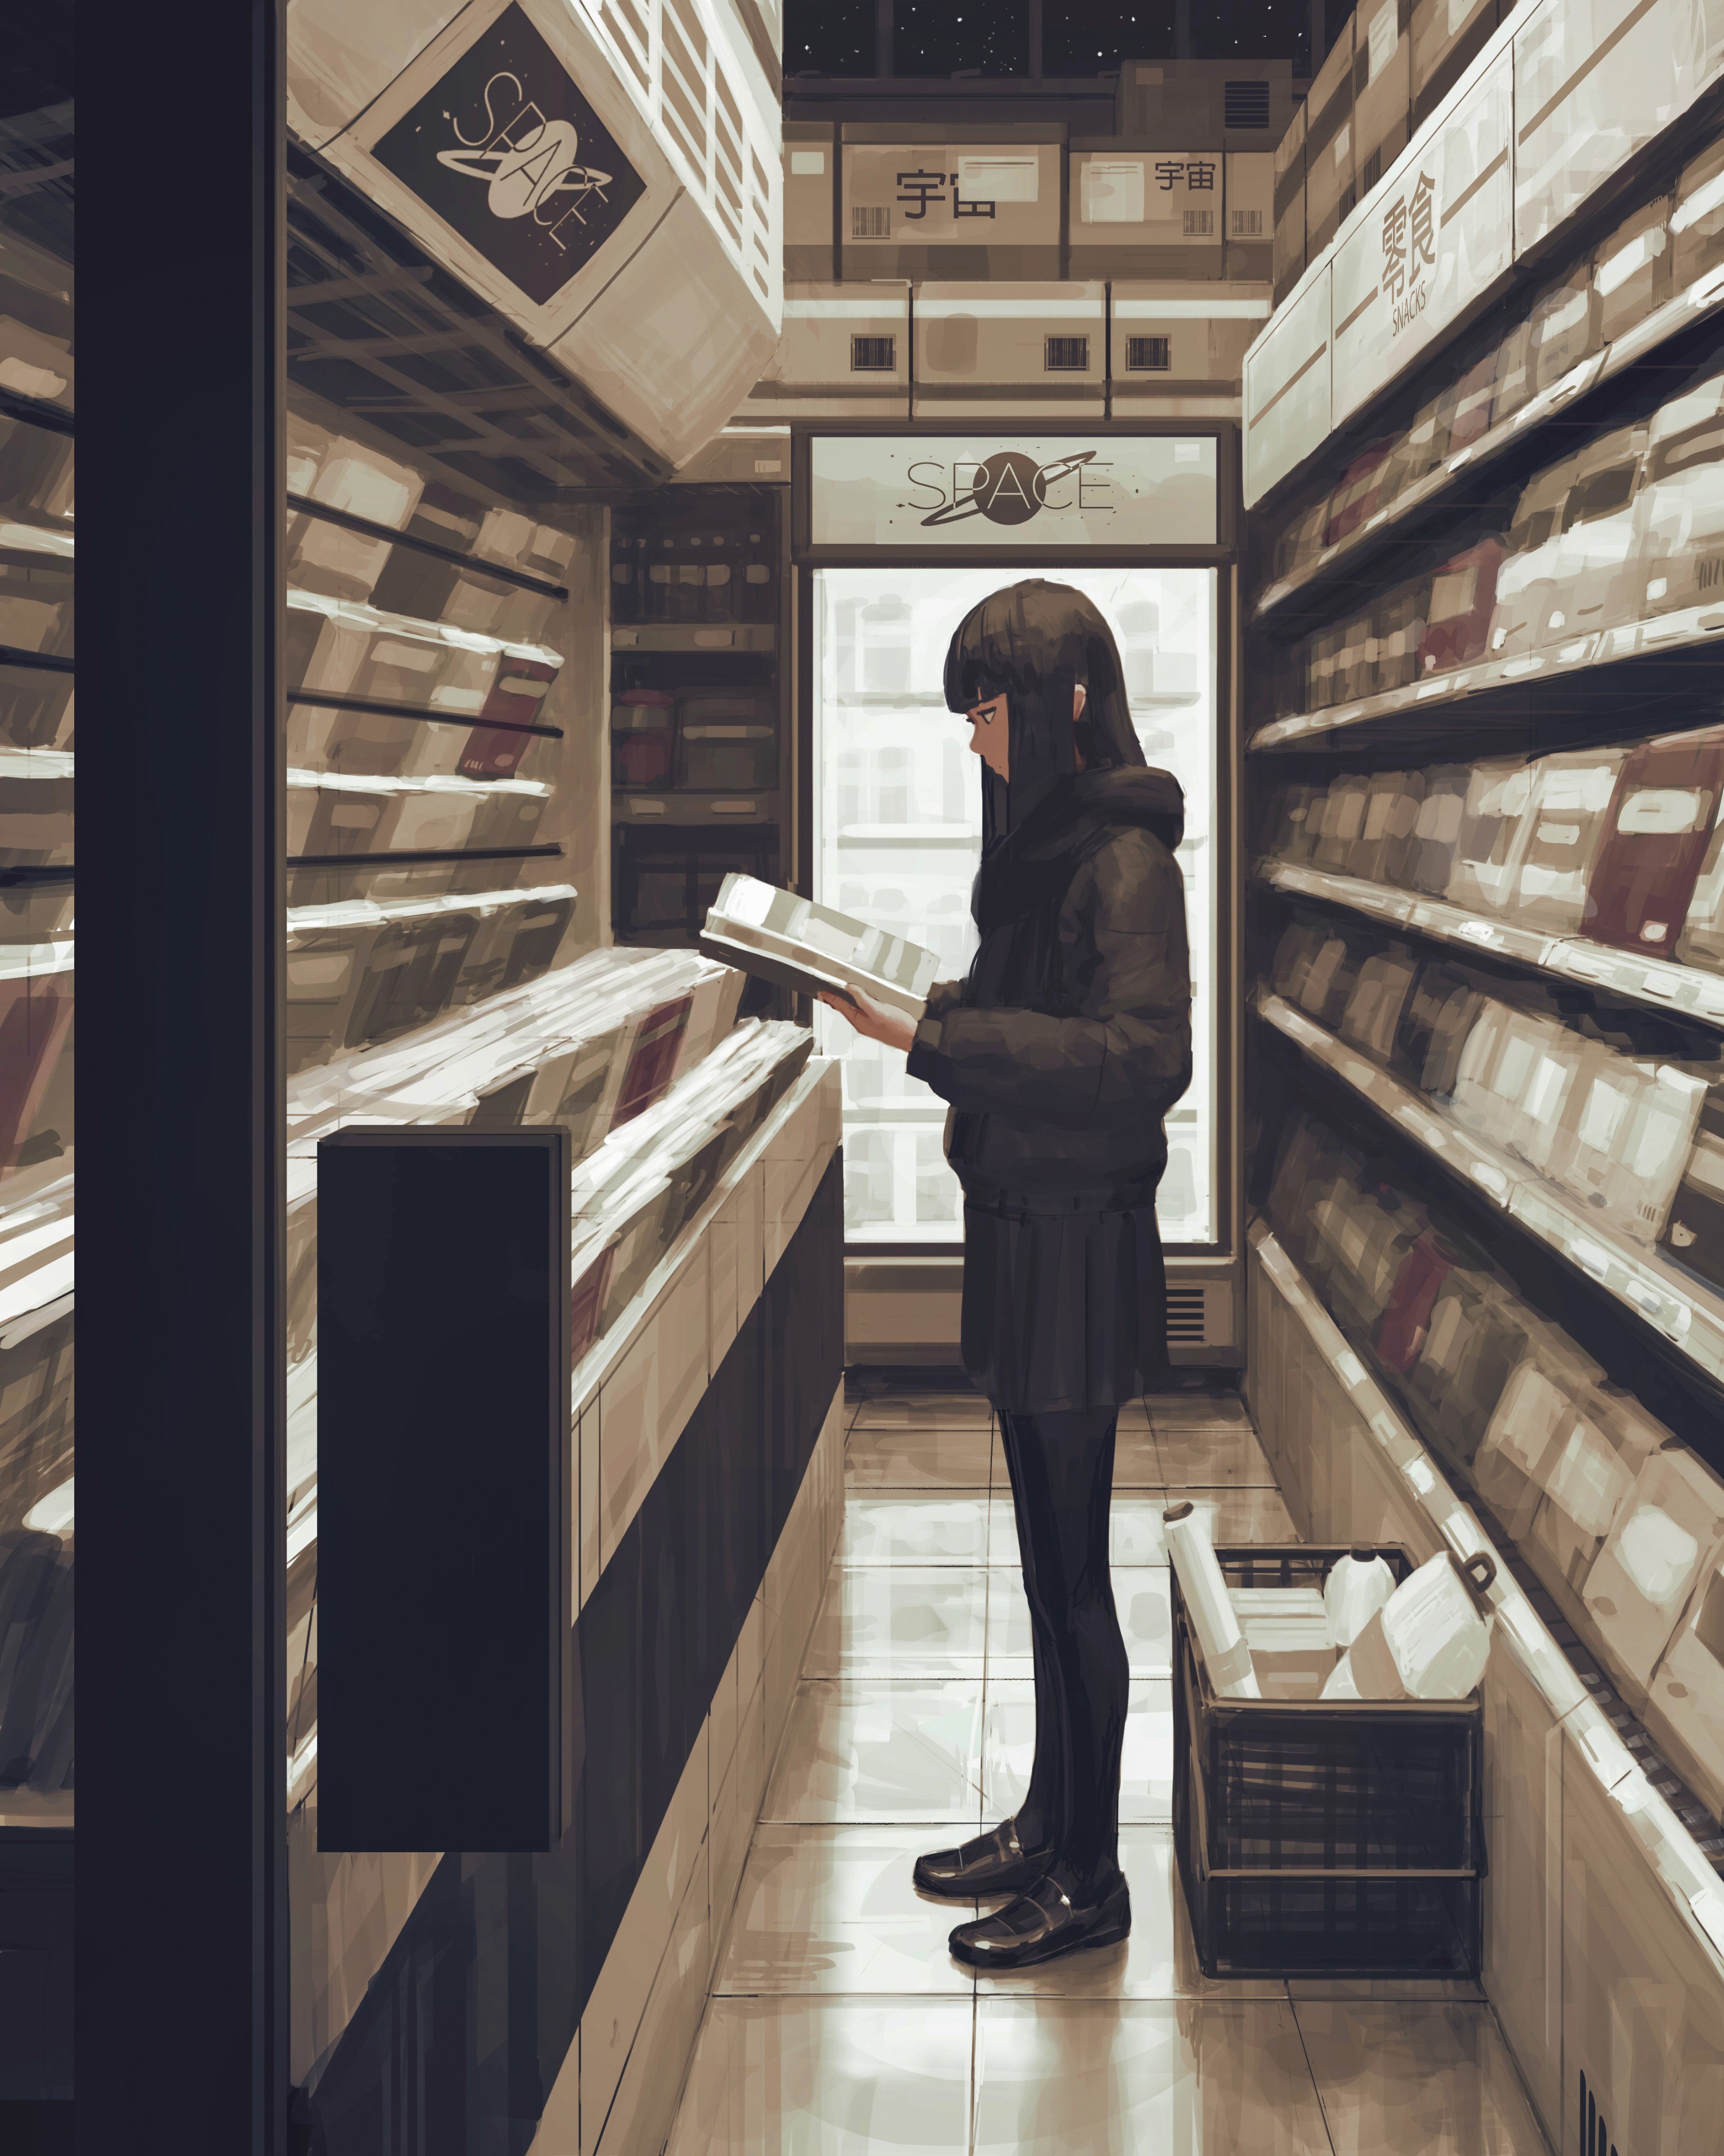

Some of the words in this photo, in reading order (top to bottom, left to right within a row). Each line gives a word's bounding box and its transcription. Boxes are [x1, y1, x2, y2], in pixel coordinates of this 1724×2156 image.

[454, 72, 608, 250] SPACE
[1155, 161, 1216, 191] 宇宙
[1382, 171, 1435, 305] 零食
[1392, 280, 1426, 337] SNACKS
[908, 462, 1114, 510] SPACE
